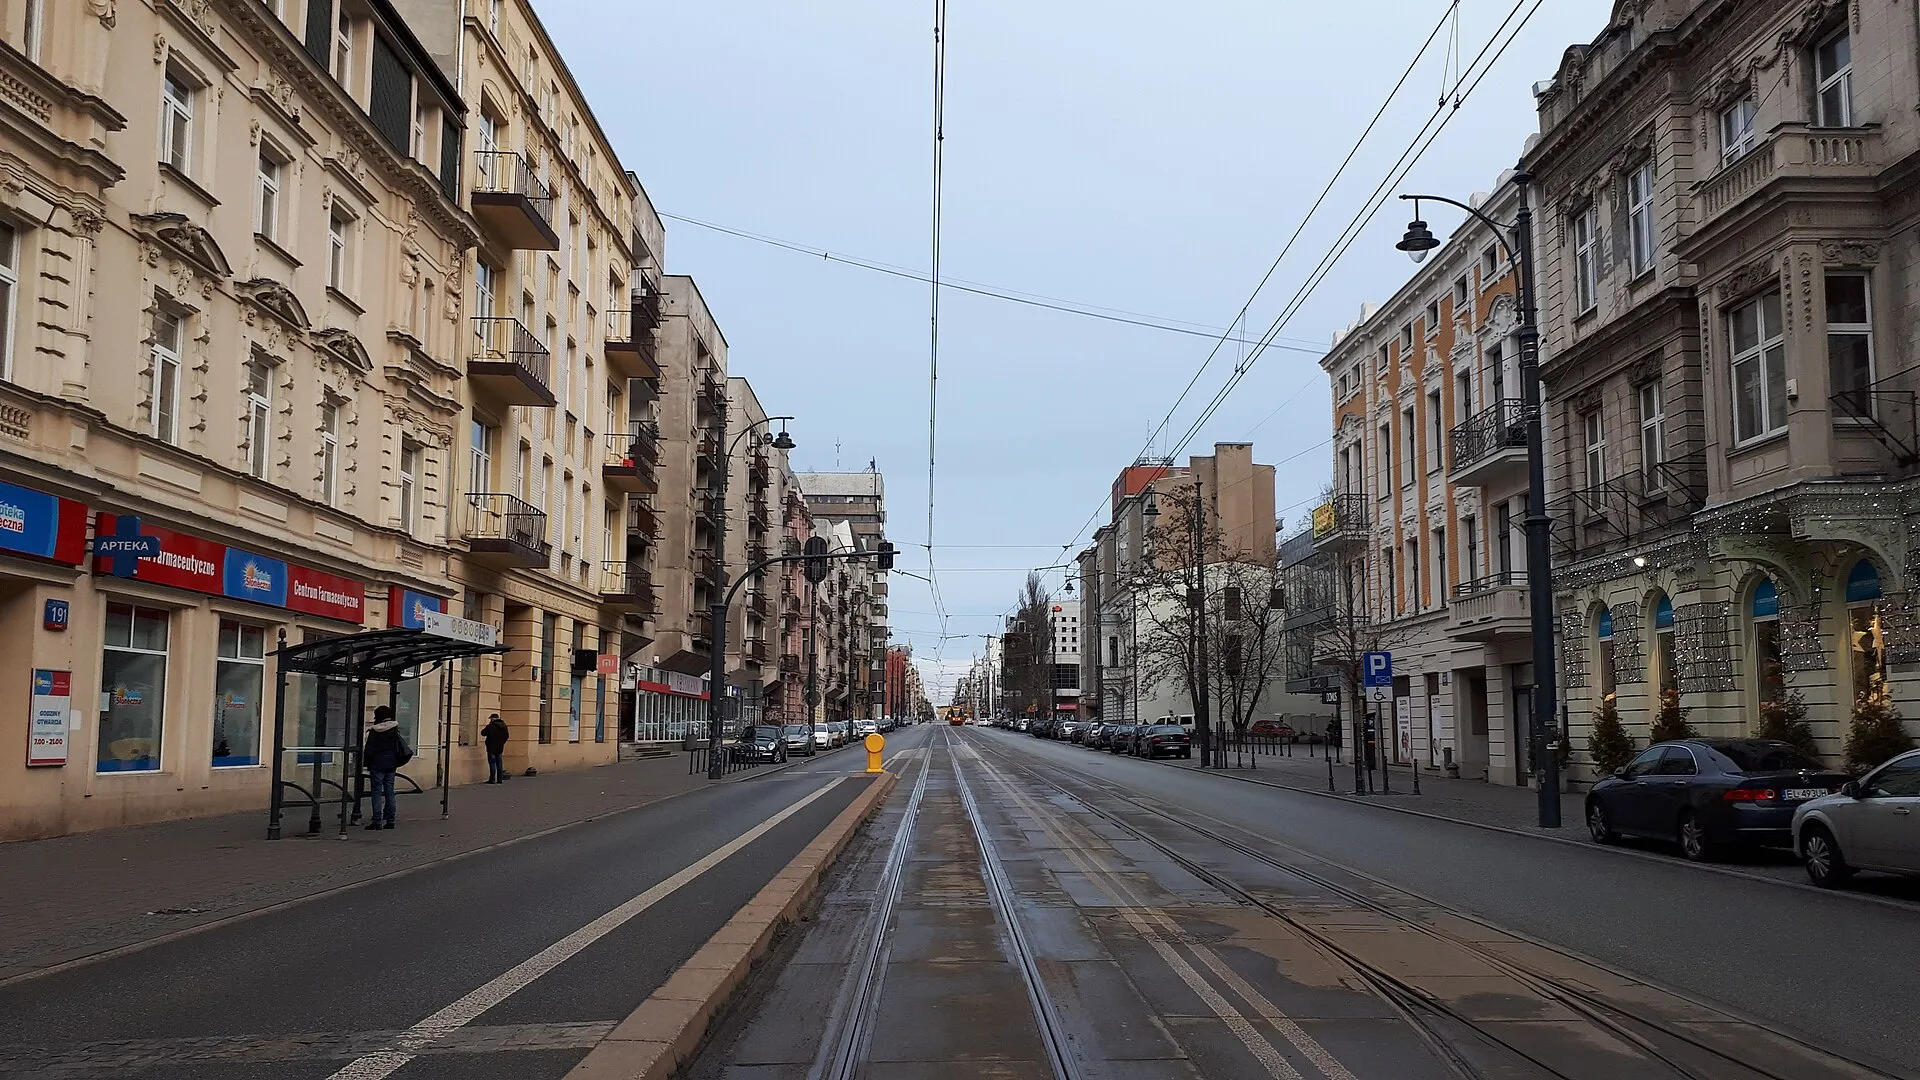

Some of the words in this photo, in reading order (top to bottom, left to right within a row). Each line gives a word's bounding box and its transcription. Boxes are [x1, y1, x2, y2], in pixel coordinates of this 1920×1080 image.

[100, 541, 149, 551] APTEKA
[294, 580, 318, 600] Centrum
[318, 586, 359, 608] Farmaceutyczne
[51, 606, 67, 623] 191
[1370, 655, 1386, 676] P
